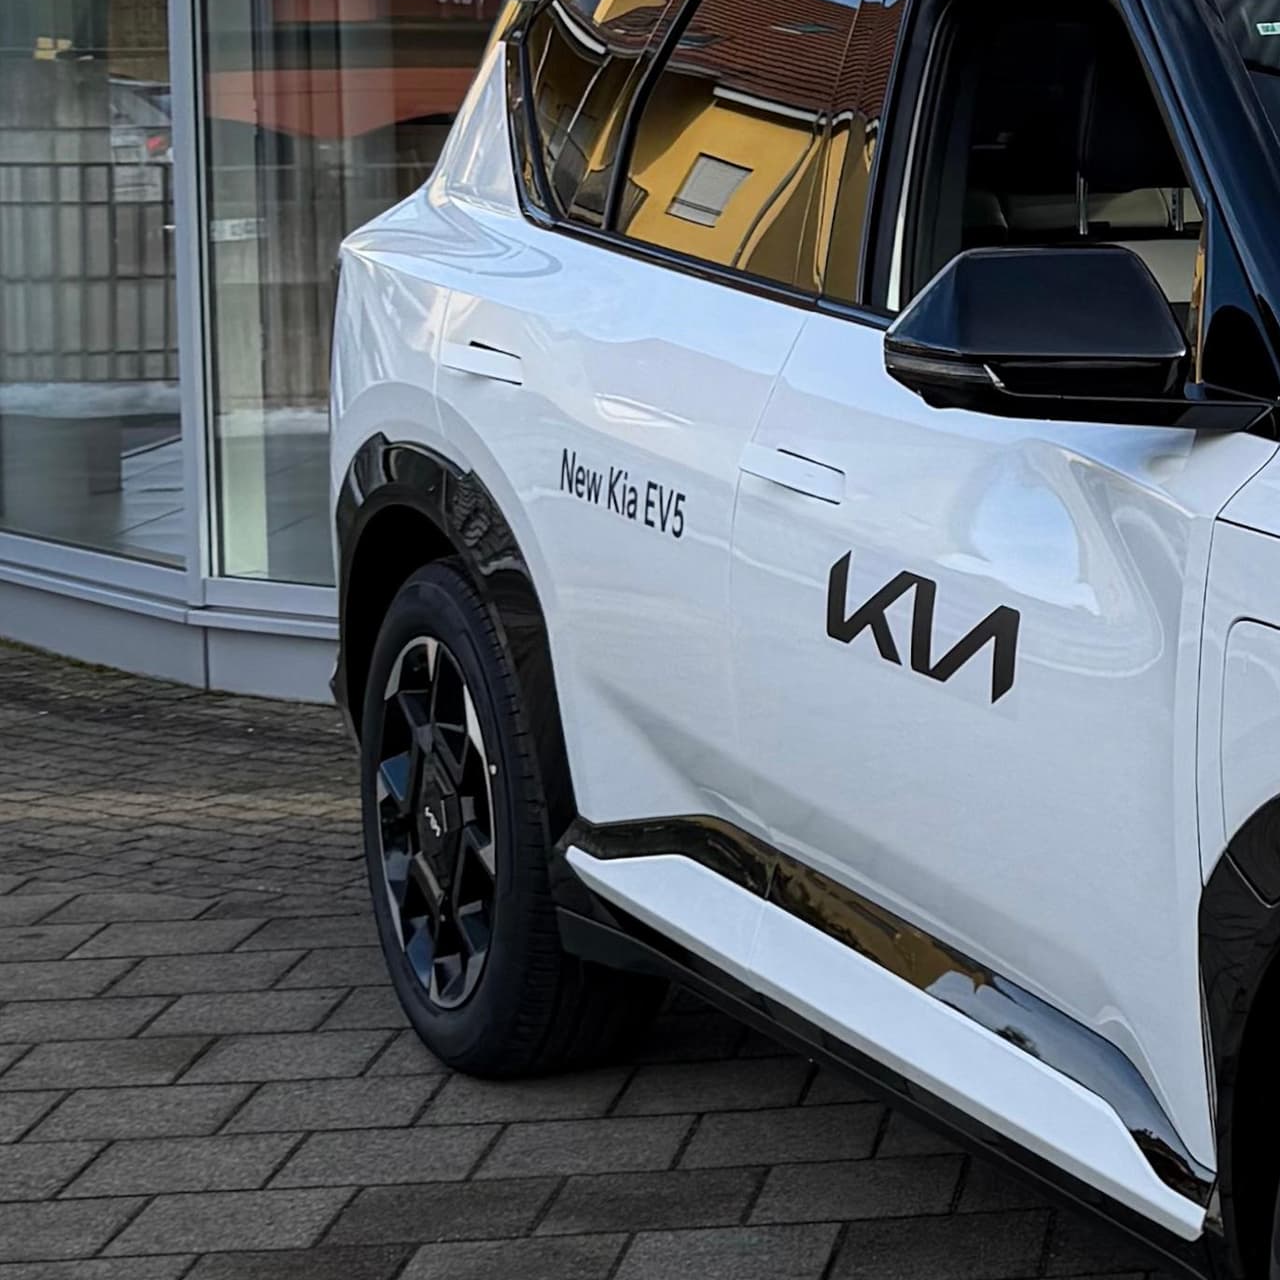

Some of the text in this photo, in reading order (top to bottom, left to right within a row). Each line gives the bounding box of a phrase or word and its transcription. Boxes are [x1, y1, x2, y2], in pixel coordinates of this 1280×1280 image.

[560, 447, 686, 539] New Kia EV5
[826, 549, 1021, 704] KIA
